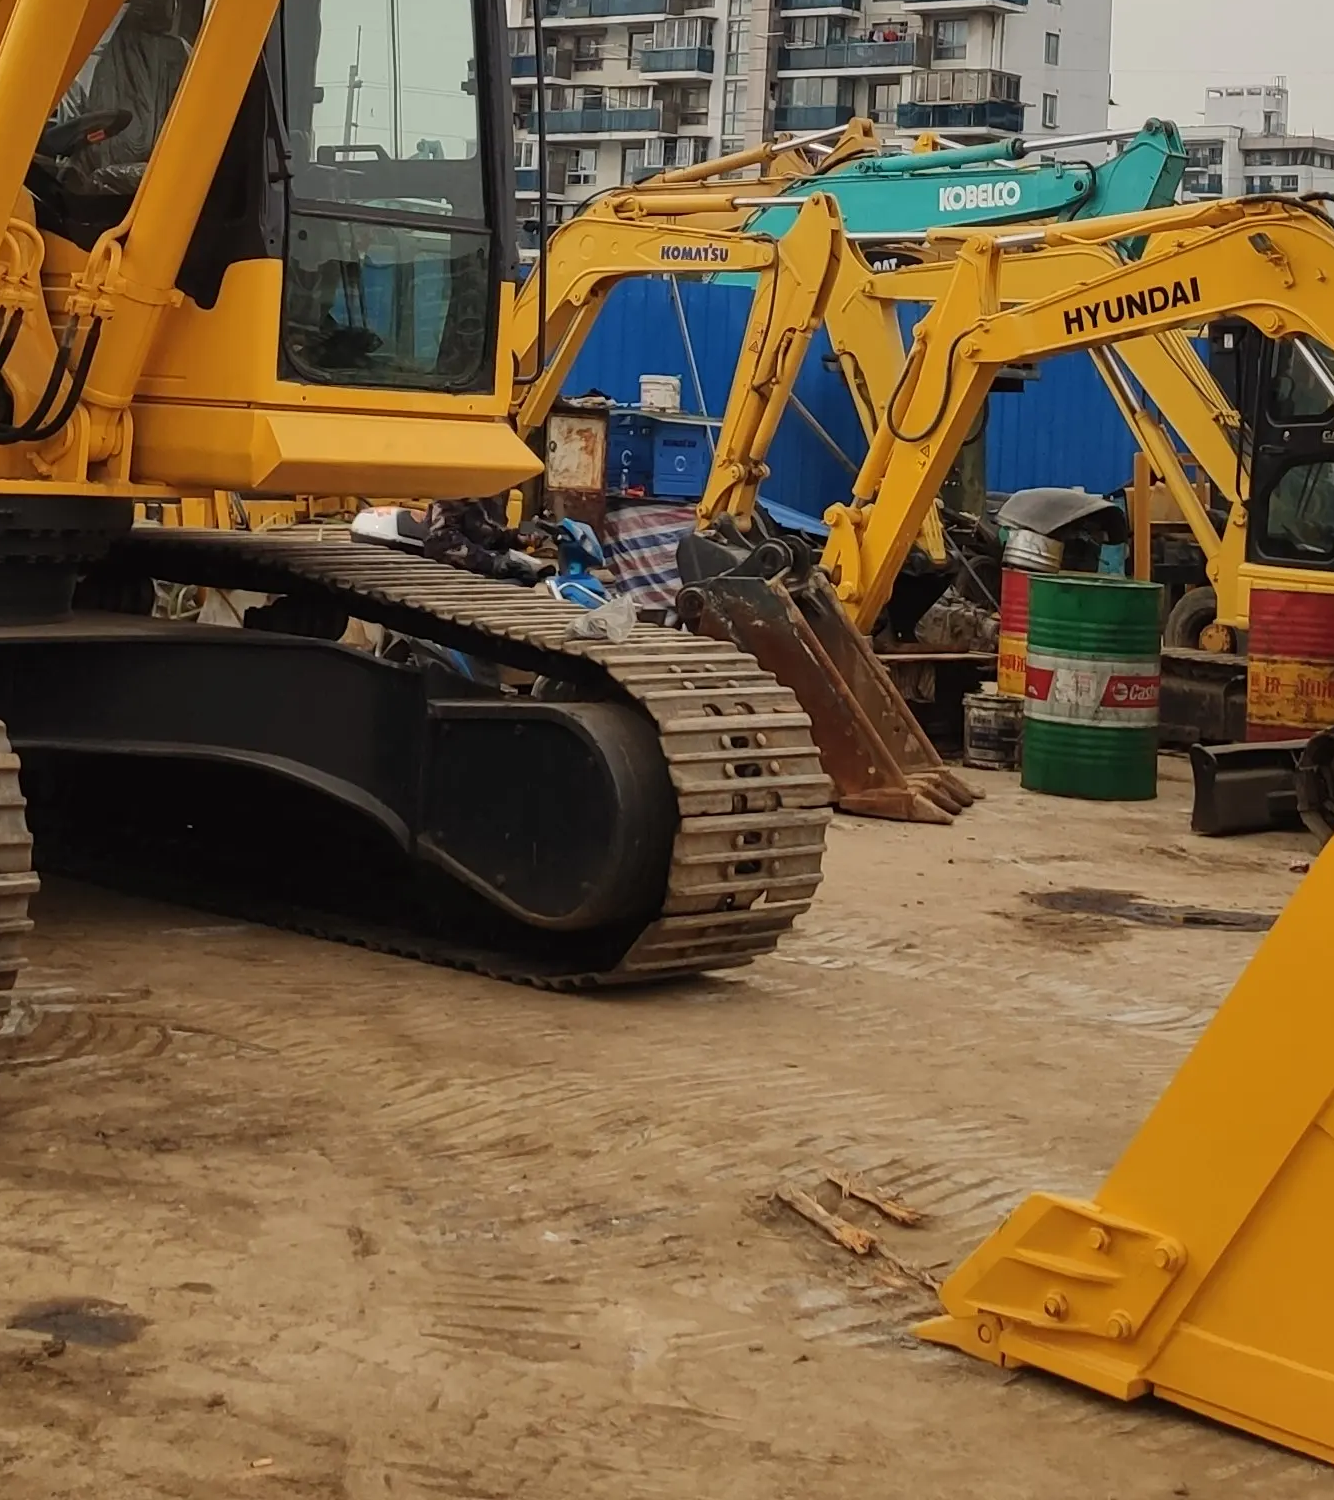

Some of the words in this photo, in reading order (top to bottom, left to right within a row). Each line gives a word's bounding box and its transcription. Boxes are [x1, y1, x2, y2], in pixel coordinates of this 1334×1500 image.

[939, 181, 1021, 212] KOBELCO
[660, 243, 730, 262] KOMATSU
[1063, 276, 1201, 335] HYUNDAI
[1129, 683, 1158, 701] Cast
